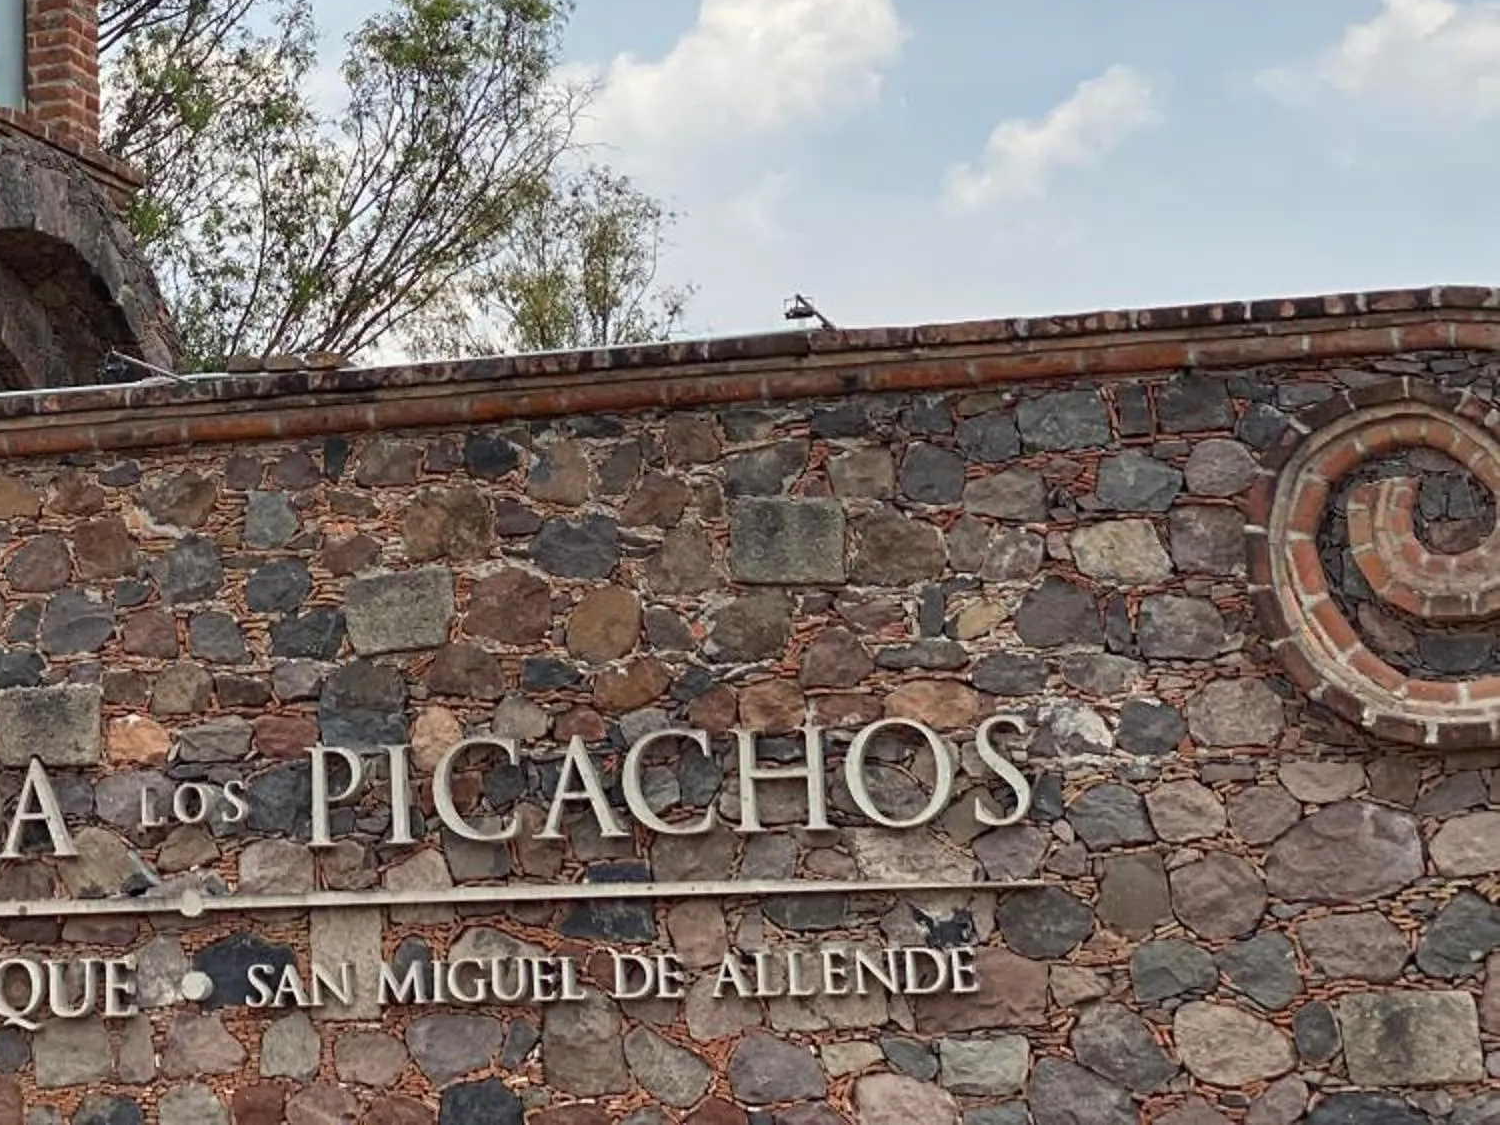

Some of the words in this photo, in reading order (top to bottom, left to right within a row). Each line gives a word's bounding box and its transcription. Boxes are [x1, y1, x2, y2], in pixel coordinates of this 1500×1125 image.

[140, 780, 250, 828] LOS
[306, 713, 1037, 849] PICACHOS
[245, 962, 355, 1010] SAN
[377, 955, 587, 1005] MIGUEL
[611, 953, 685, 1000] DE
[712, 946, 980, 998] ALLENDE
